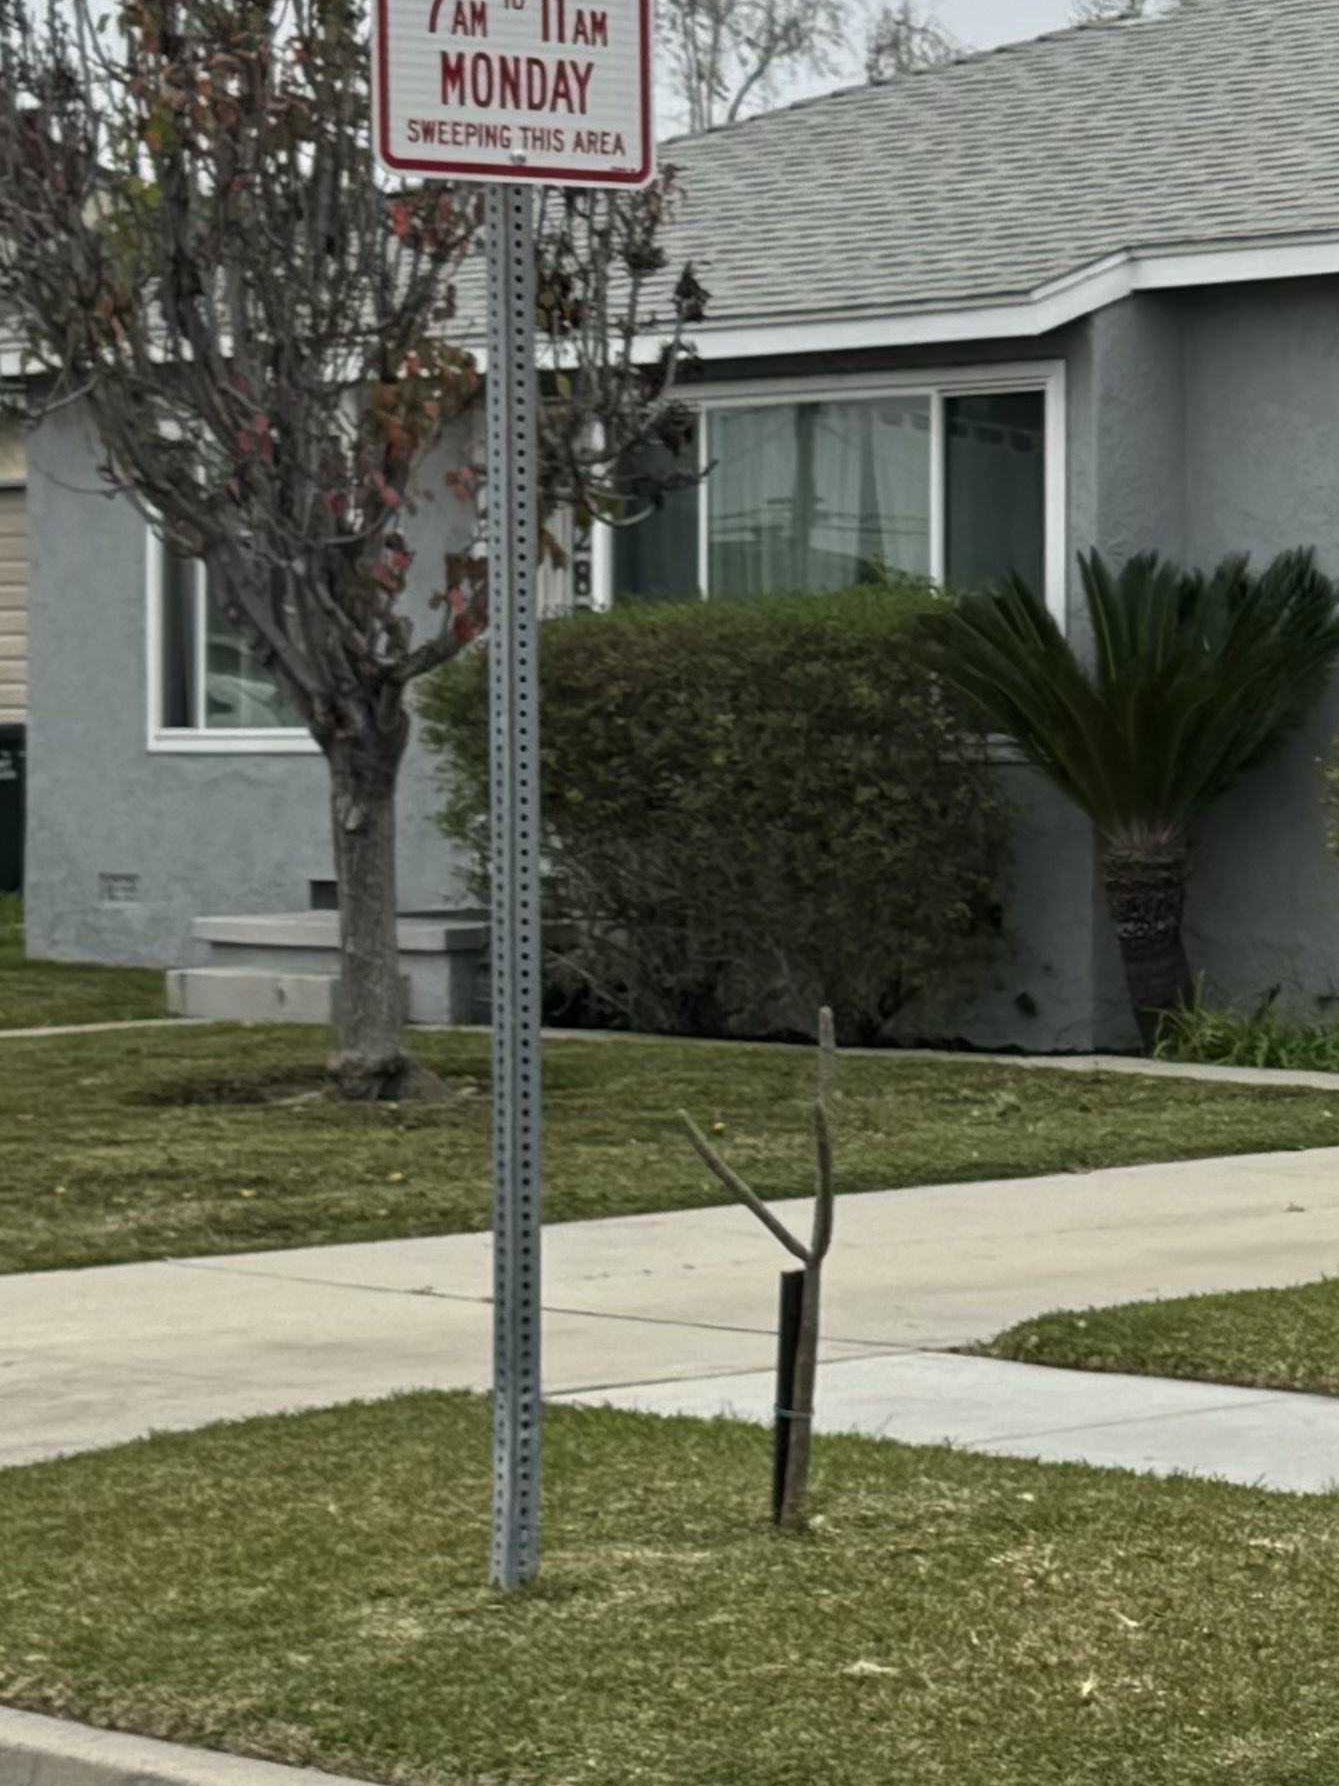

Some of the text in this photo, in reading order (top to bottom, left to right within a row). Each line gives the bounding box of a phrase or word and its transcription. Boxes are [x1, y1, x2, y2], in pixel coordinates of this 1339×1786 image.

[440, 50, 595, 115] MONDAY
[407, 119, 626, 156] SWEEPING THIS AREA
